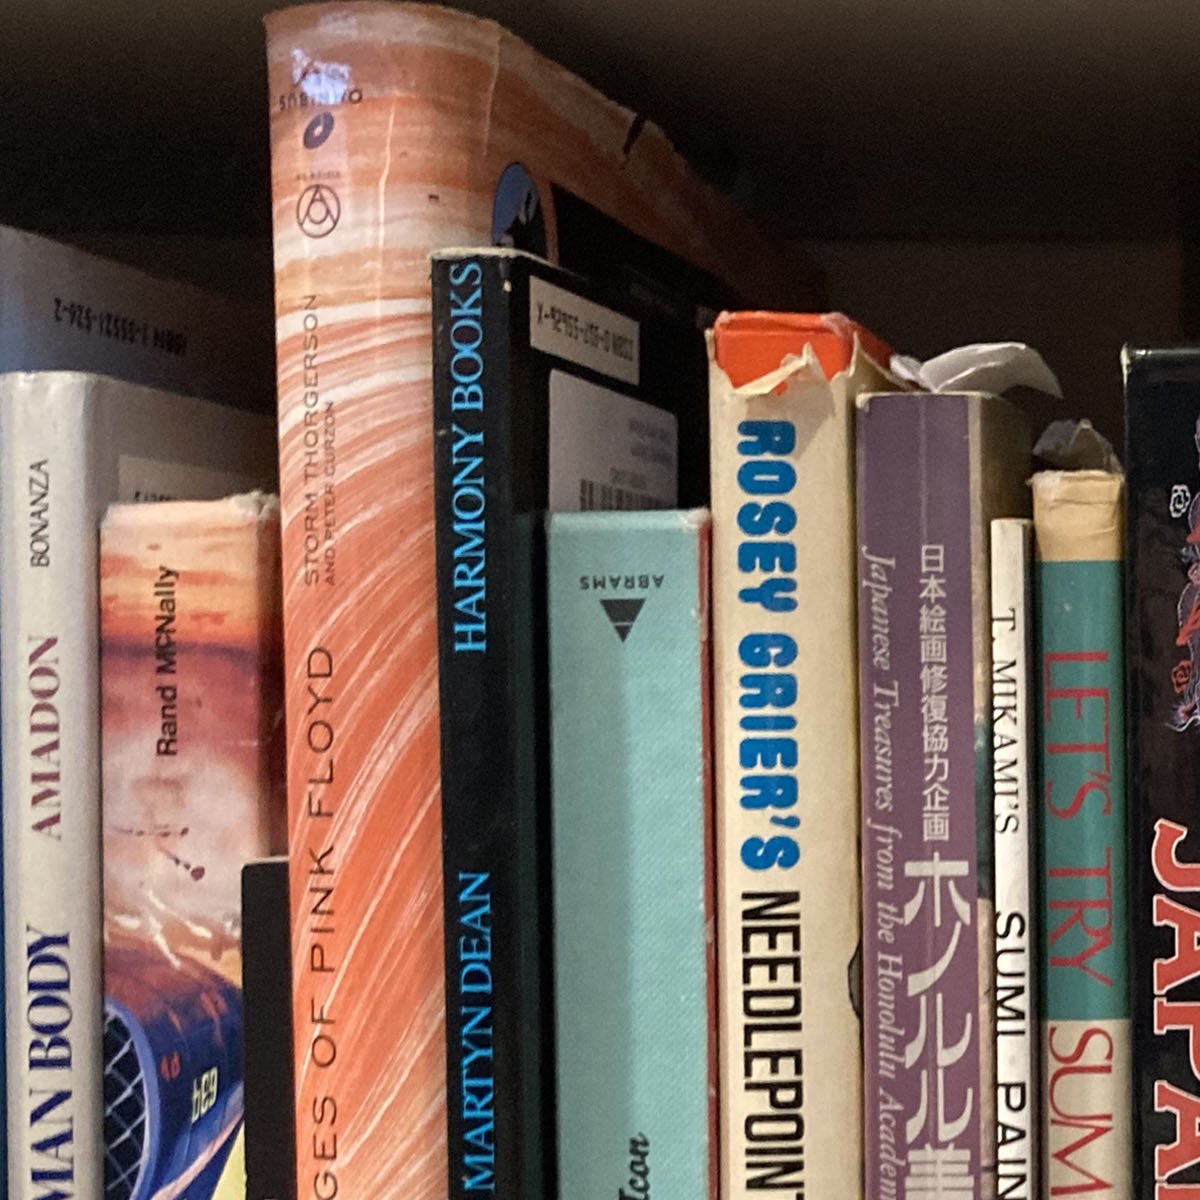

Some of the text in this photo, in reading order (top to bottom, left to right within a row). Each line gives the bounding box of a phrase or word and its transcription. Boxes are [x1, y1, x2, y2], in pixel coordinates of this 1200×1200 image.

[303, 294, 320, 586] STORM THORGERSON
[451, 262, 487, 653] HARMONY BOOKS
[30, 459, 50, 568] BONANZA
[324, 485, 336, 540] PETER
[324, 545, 336, 585] AND
[737, 420, 798, 613] ROSEY
[580, 574, 665, 590] ABRAMS
[862, 546, 897, 671] Japanese
[991, 607, 1016, 643] T.
[29, 635, 62, 841] AMADON
[155, 683, 179, 756] Rand
[307, 645, 334, 817] FLOYD
[738, 633, 801, 871] GRIER'S
[867, 680, 901, 812] Treasures
[918, 544, 950, 842] 日本絵画修復協力企画
[992, 658, 1021, 835] MIKAMI'S
[1044, 651, 1112, 820] LET'S
[310, 842, 336, 973] PINK
[866, 819, 902, 890] from
[1047, 850, 1112, 988] TRY
[460, 873, 493, 995] DEAN
[876, 900, 903, 943] the
[994, 911, 1027, 1036] SUMI
[27, 924, 73, 1073] BODY
[312, 1005, 337, 1067] OF
[877, 953, 903, 1078] Honolulu
[463, 1007, 496, 1195] MARTYN
